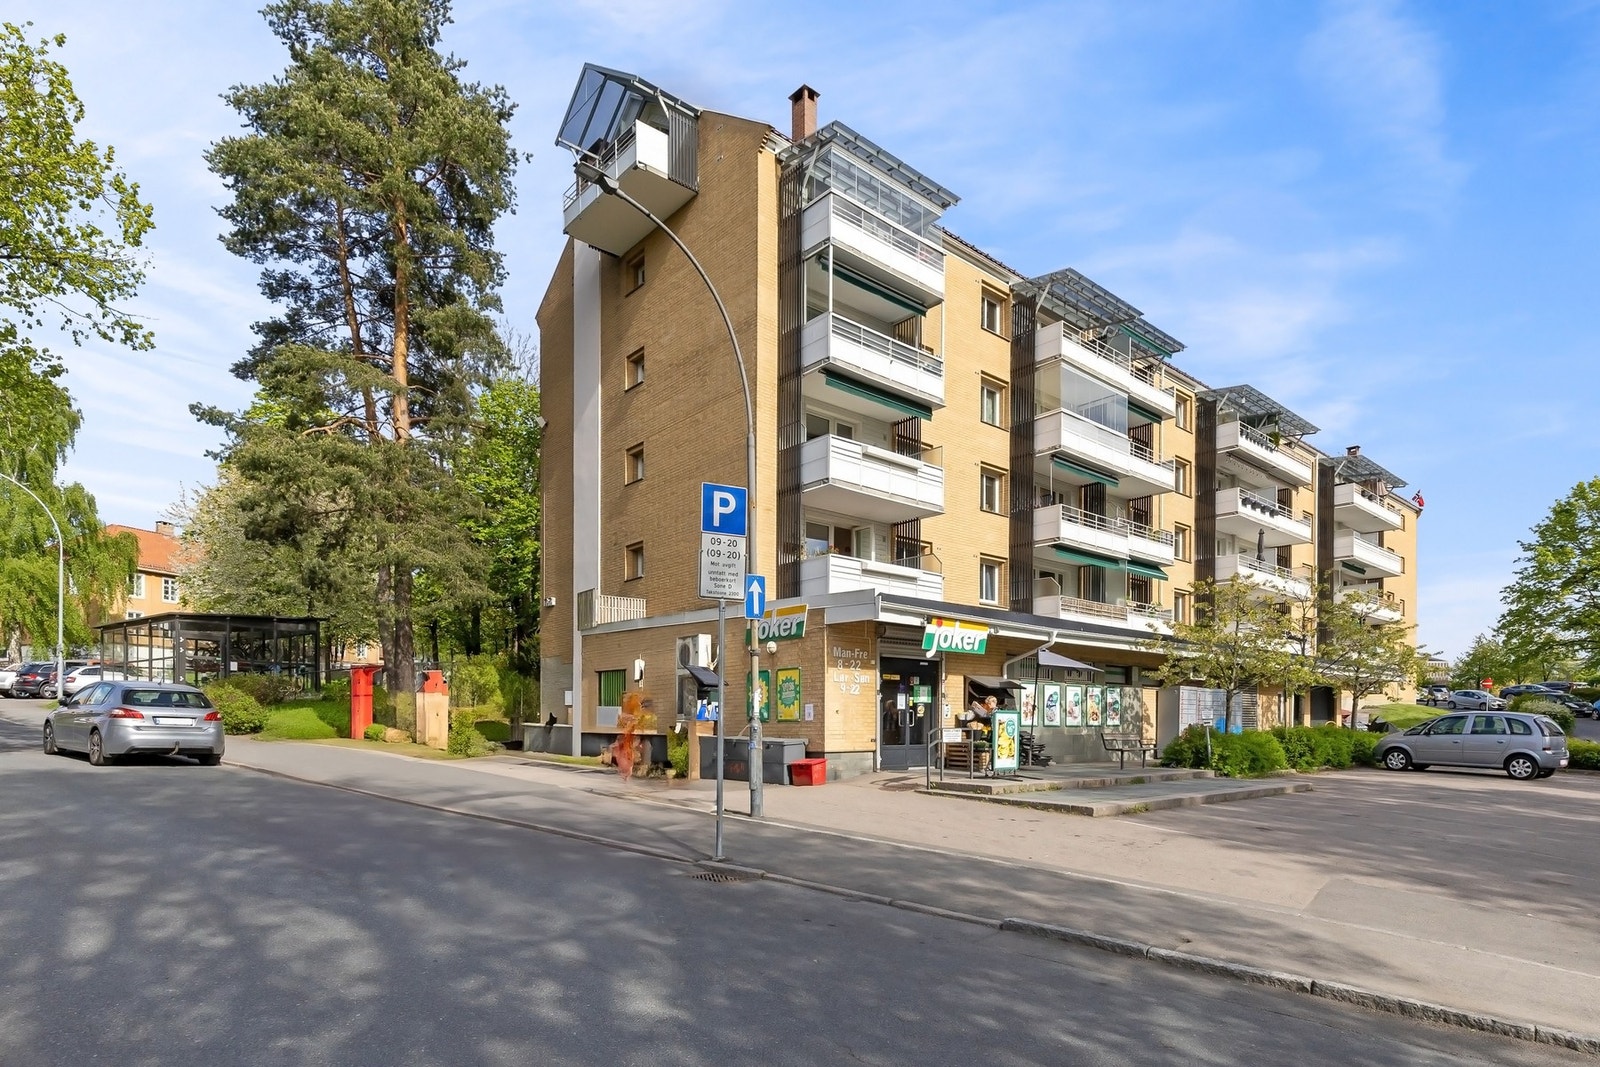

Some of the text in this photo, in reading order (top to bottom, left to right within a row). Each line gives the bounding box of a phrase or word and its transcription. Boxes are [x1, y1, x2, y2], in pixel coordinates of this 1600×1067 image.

[713, 490, 736, 527] P
[758, 608, 804, 640] oker
[833, 646, 868, 660] Man-Fre
